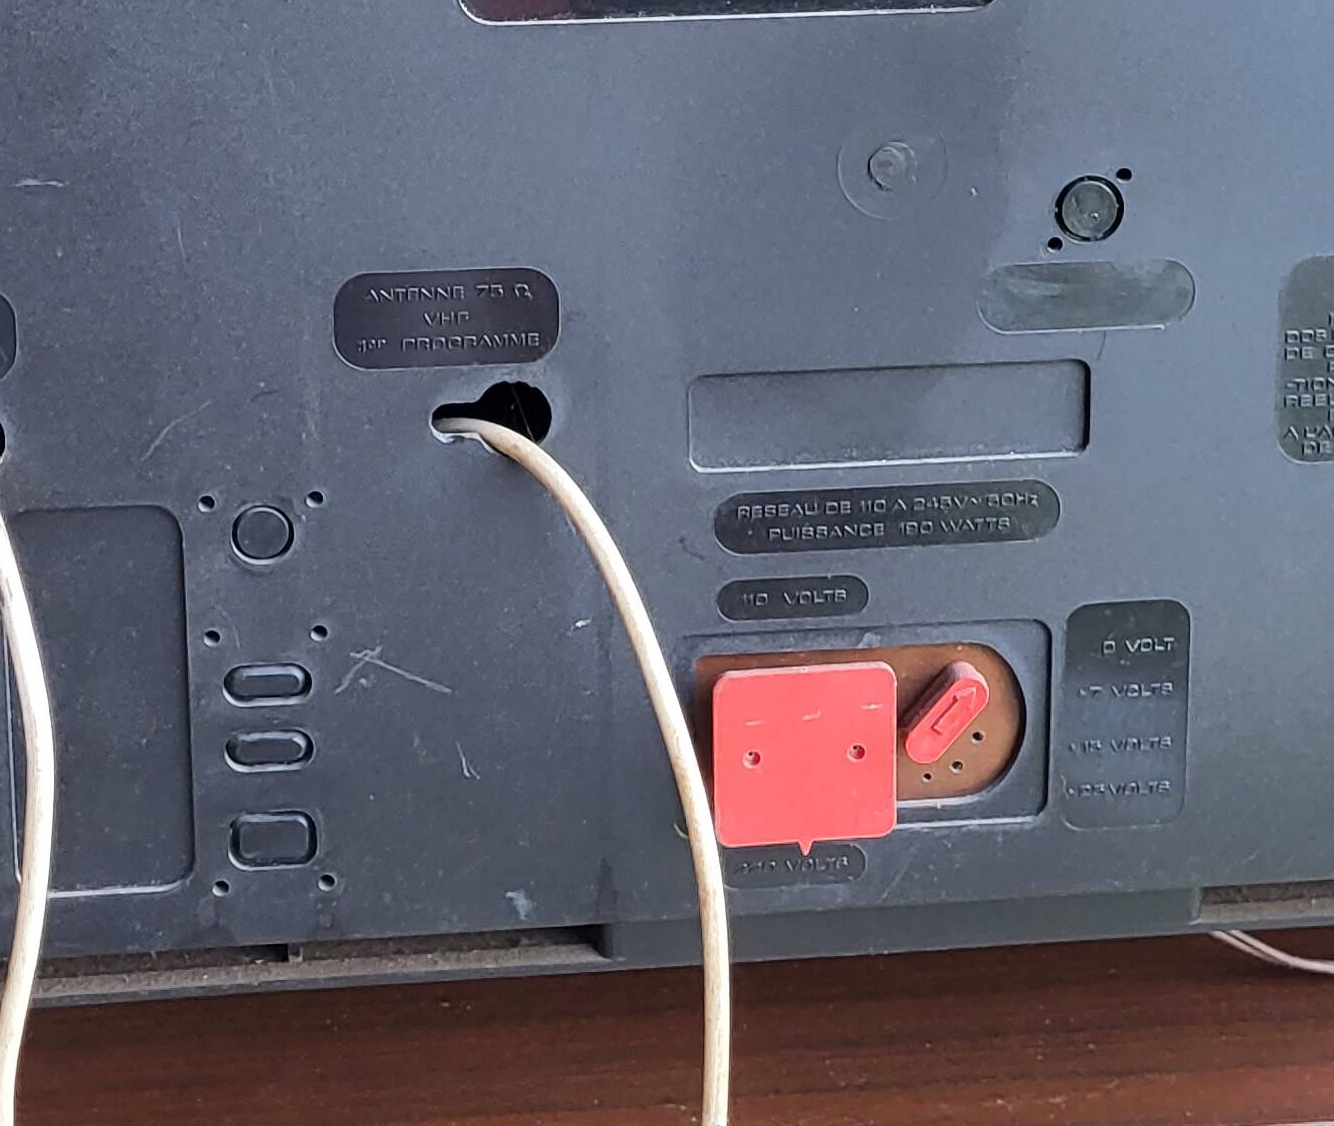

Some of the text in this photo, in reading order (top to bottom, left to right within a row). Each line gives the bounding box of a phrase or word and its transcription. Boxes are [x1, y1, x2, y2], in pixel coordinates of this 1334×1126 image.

[366, 285, 465, 303] ANTENNE
[475, 284, 503, 299] 75
[424, 311, 469, 327] VHF
[402, 332, 540, 352] PROGRAMME
[1285, 346, 1315, 361] DE
[1285, 425, 1299, 441] A
[1302, 439, 1333, 455] DE
[737, 502, 818, 520] RESEAU
[825, 500, 852, 515] DE
[860, 498, 887, 514] 110
[891, 497, 908, 513] A
[768, 523, 885, 541] PUISSANCE
[940, 516, 1011, 532] WATTS
[742, 589, 847, 607] 110 VOLTS
[1125, 637, 1175, 653] VOLT
[1111, 681, 1173, 697] VOLTS
[1109, 735, 1172, 752] VOLTS
[1108, 779, 1171, 795] VOLTS
[786, 856, 849, 872] VOLTS
